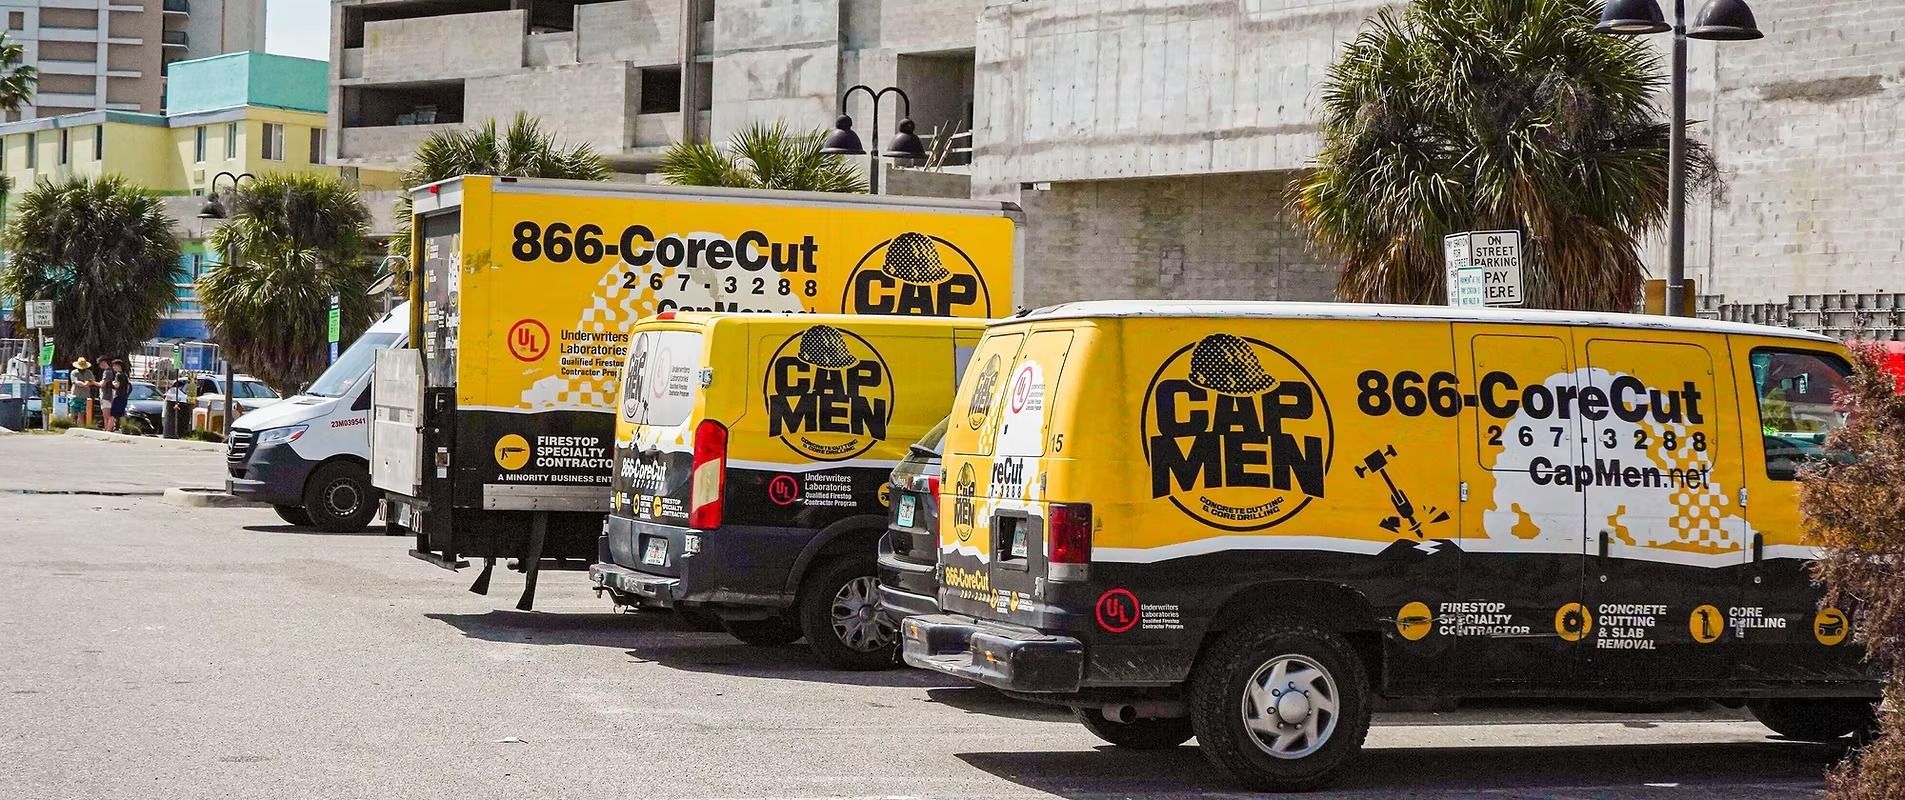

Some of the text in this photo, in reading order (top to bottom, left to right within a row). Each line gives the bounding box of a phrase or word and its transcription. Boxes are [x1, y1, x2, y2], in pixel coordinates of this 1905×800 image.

[1487, 235, 1502, 246] ON
[511, 221, 818, 273] 866-CoreCut
[1476, 246, 1514, 257] STREET
[1474, 256, 1517, 267] PARKING
[1485, 271, 1508, 284] PAY
[855, 270, 978, 317] CAP
[1484, 286, 1515, 299] HERE
[518, 328, 539, 352] UL
[561, 330, 628, 342] Underwriters
[561, 343, 628, 355] Laboratories
[561, 358, 593, 366] Qualified
[561, 367, 600, 376] Contractor
[775, 356, 881, 400] CAP
[1356, 370, 1704, 424] 866-CoreCut
[1156, 379, 1313, 436] CAP
[331, 418, 366, 428] 23M039541
[769, 394, 886, 441] MEN
[537, 436, 599, 447] FIRESTOP
[1051, 434, 1063, 452] 15
[537, 447, 606, 458] SPECIALTY
[621, 458, 667, 481] 866-CoreCut
[1151, 431, 1324, 499] MEN
[805, 473, 851, 482] Underwriters
[992, 458, 1023, 485] reCut
[1529, 456, 1710, 492] CapMen.net
[506, 474, 549, 482] MINORITY
[551, 475, 594, 483] BUSINESS
[776, 482, 790, 498] UL
[805, 482, 851, 492] Laboratories
[805, 492, 852, 501] Qualified Firestop
[805, 499, 857, 507] Contractor Program
[1200, 496, 1284, 514] CONCRETE CUTTING
[1211, 508, 1236, 520] CORE
[1237, 506, 1280, 520] DRILLING
[945, 566, 989, 592] 866-CoreCut
[1107, 599, 1128, 622] UL
[1440, 603, 1505, 613] FIRESTOP
[1599, 604, 1667, 615] CONCRETE
[1729, 607, 1763, 617] CORE
[1600, 616, 1656, 627] CUTTING
[1598, 628, 1644, 639] & SLAB
[1597, 639, 1656, 650] REMOVAL
